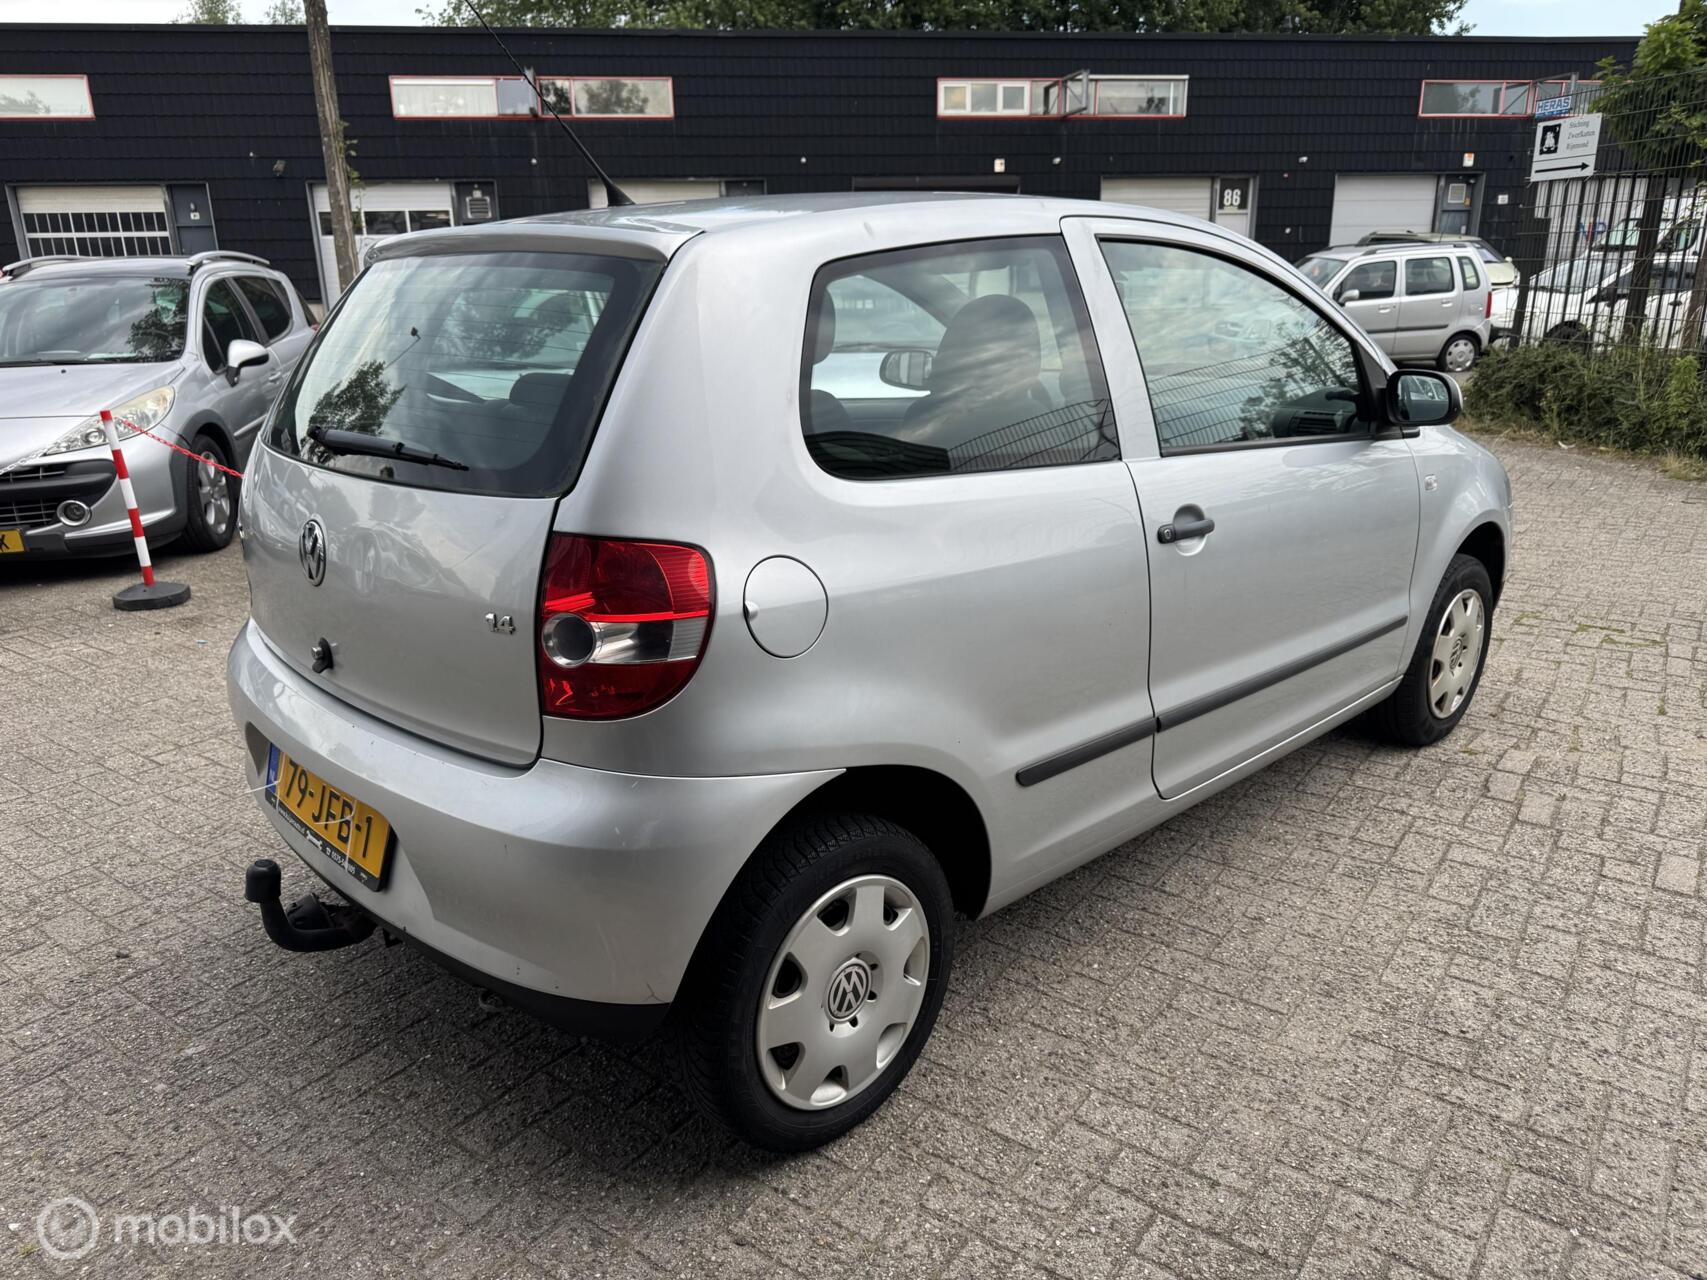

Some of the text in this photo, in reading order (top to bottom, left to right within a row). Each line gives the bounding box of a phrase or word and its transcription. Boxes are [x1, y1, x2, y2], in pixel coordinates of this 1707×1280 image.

[1537, 97, 1570, 112] HERAS
[1223, 188, 1241, 206] 86
[286, 758, 373, 858] 79-JFB-1
